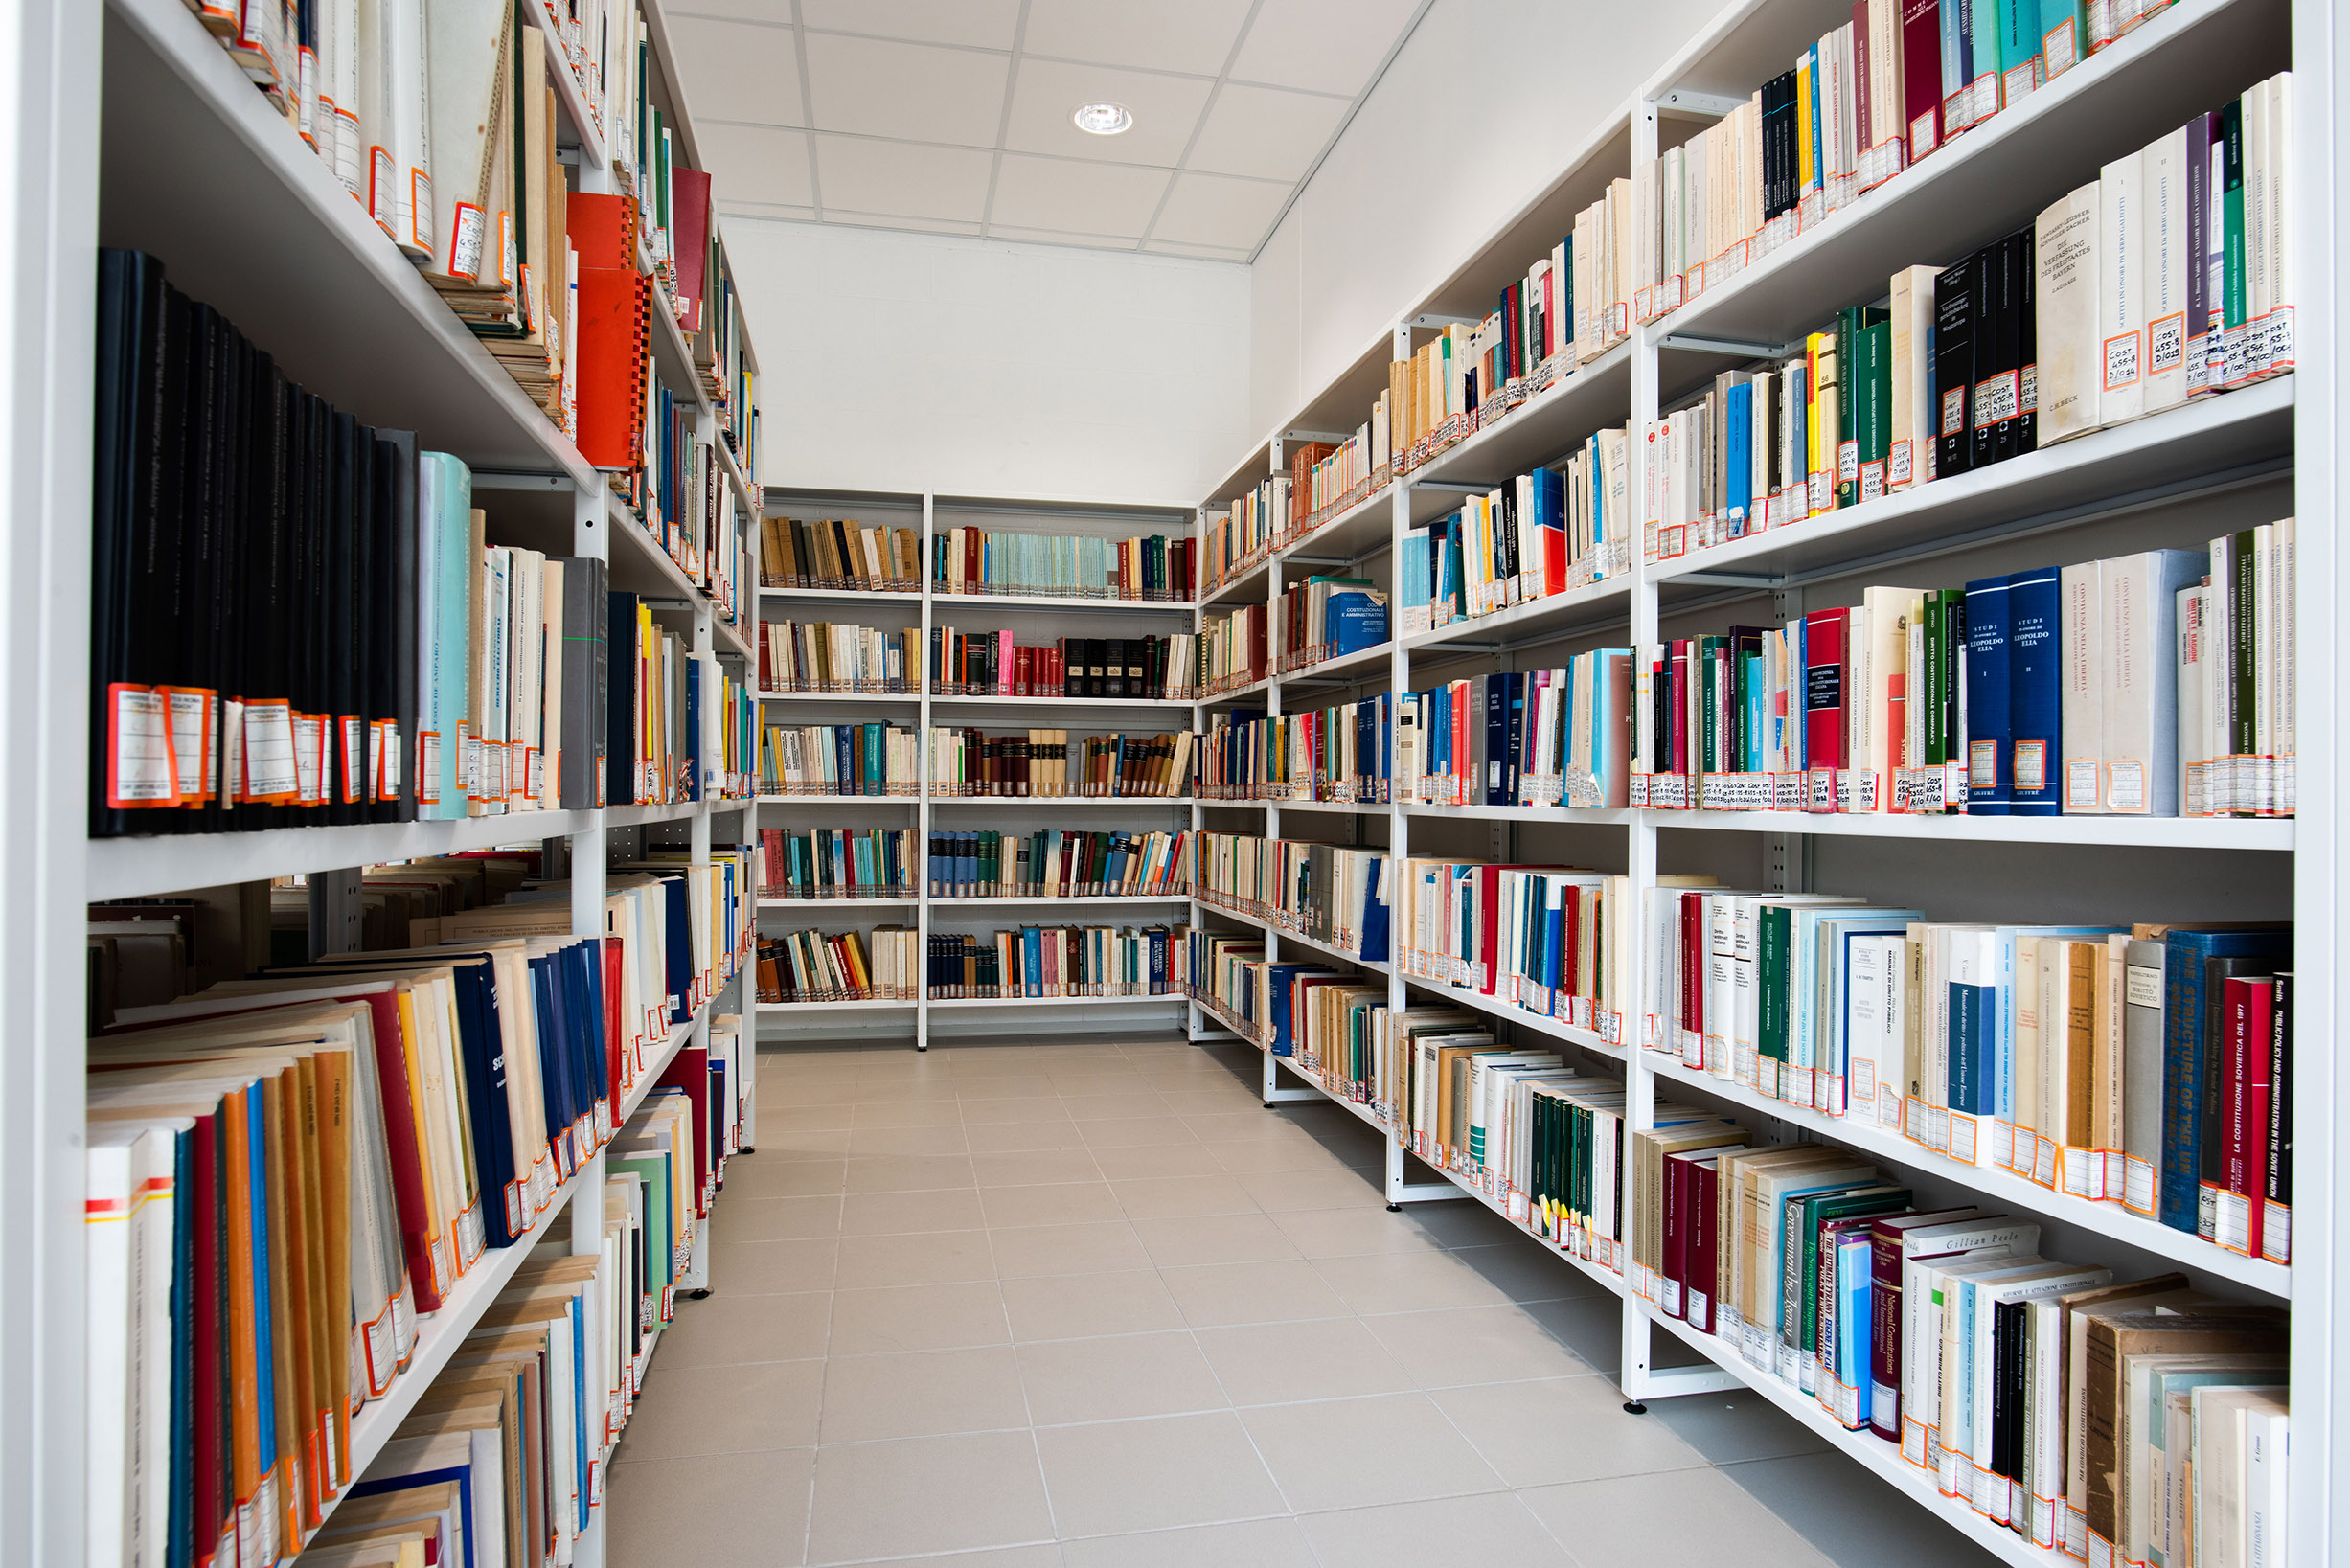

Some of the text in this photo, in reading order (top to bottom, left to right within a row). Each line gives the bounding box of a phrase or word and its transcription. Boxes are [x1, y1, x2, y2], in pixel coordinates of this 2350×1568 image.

[2057, 240, 2067, 250] DIE
[2161, 237, 2167, 246] DI
[2044, 240, 2084, 267] VERFASSUNG
[2119, 255, 2125, 264] DI
[2040, 246, 2091, 279] DES FREISTAATES
[2052, 263, 2076, 280] BAYERN
[2161, 273, 2167, 282] IN
[2119, 291, 2125, 299] IN
[2156, 329, 2177, 341] COST
[2156, 337, 2179, 353] 455-8
[2108, 348, 2131, 360] COST
[2112, 355, 2136, 369] 455-8
[1991, 384, 2010, 396] COST
[1993, 392, 2013, 404] 455-8
[2049, 394, 2078, 412] C.H.BECK
[1970, 638, 2003, 647] LEOPOLDO
[2014, 632, 2049, 641] LEOPOLDO
[433, 688, 438, 698] DE
[2170, 983, 2180, 1058] GENERAL
[2179, 948, 2195, 1174] THE STRUCTURE OF THE UN
[2234, 1143, 2241, 1153] LA
[2270, 1152, 2278, 1174] SOVIET
[2269, 1176, 2277, 1197] UNION
[1946, 1233, 2019, 1250] Gillian Peele
[1784, 1205, 1800, 1337] Government by Agency
